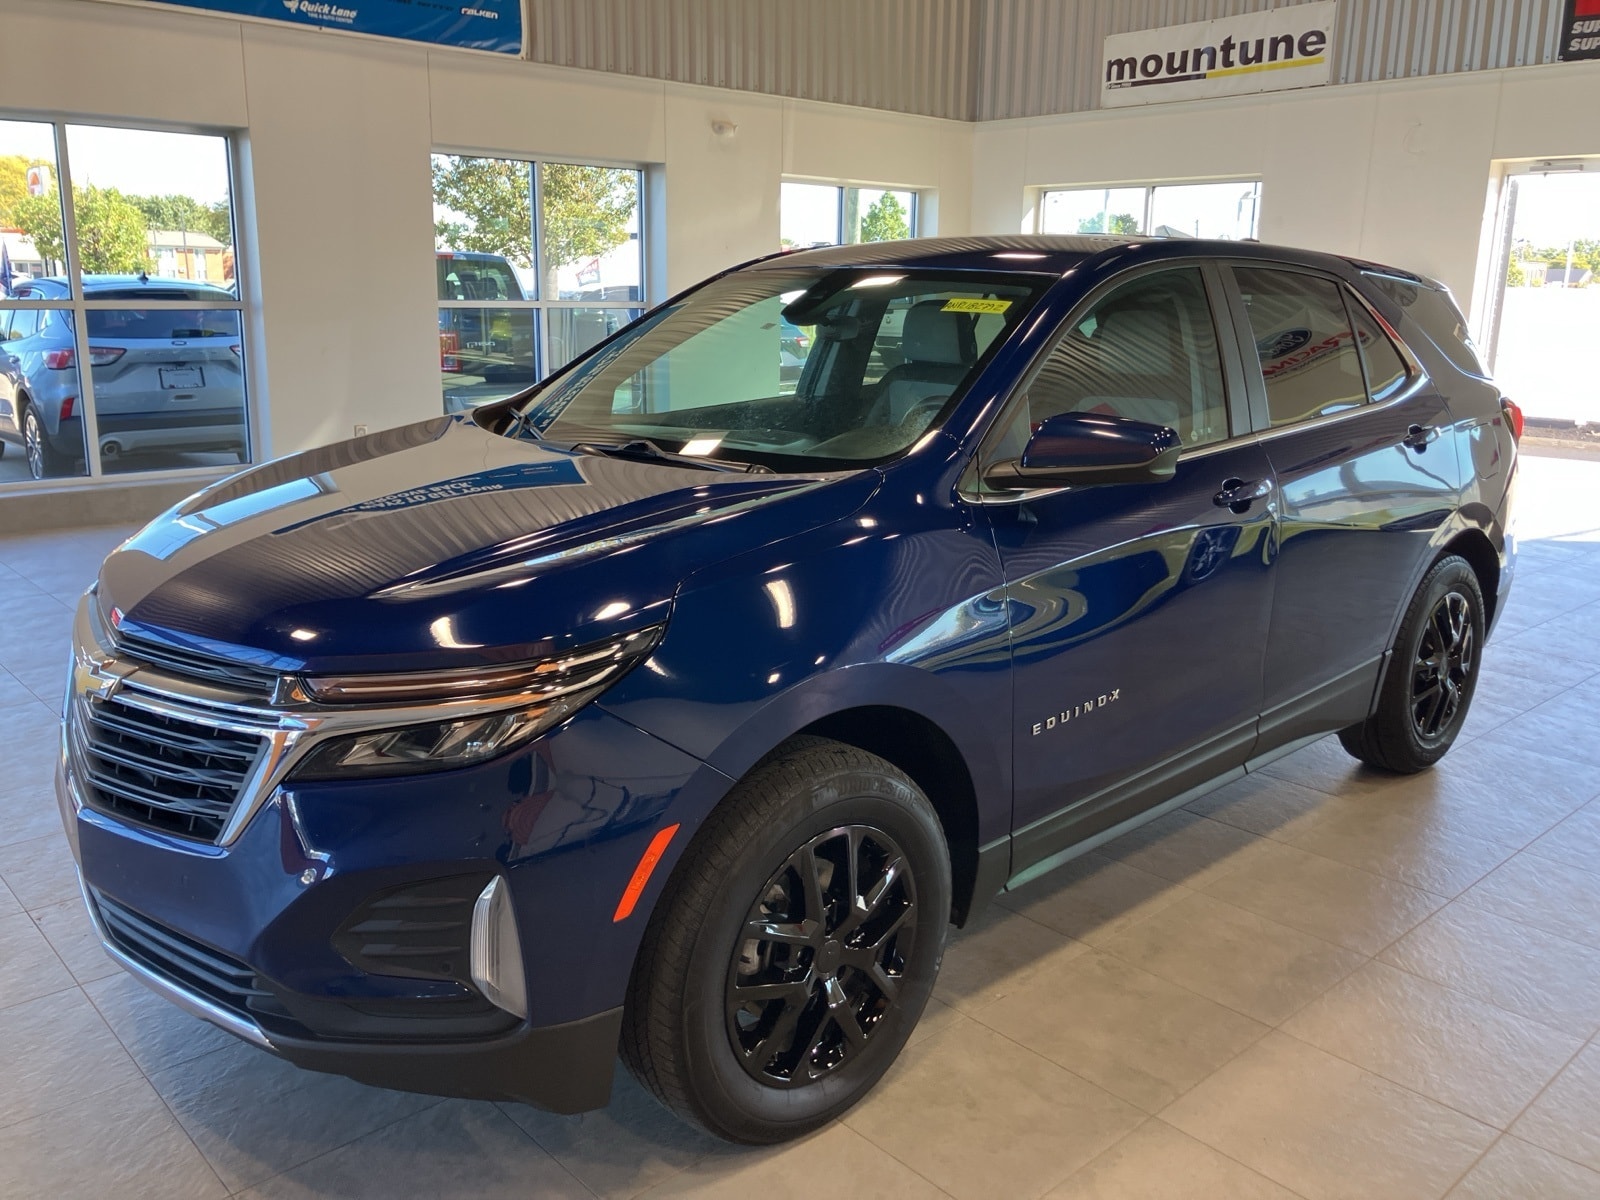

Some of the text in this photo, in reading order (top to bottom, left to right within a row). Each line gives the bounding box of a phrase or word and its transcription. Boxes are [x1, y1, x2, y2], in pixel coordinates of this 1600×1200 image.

[299, 0, 357, 18] Quick Lane
[461, 7, 499, 20] FALKEN
[1106, 29, 1326, 82] mountune
[1032, 689, 1120, 736] EQUINOX
